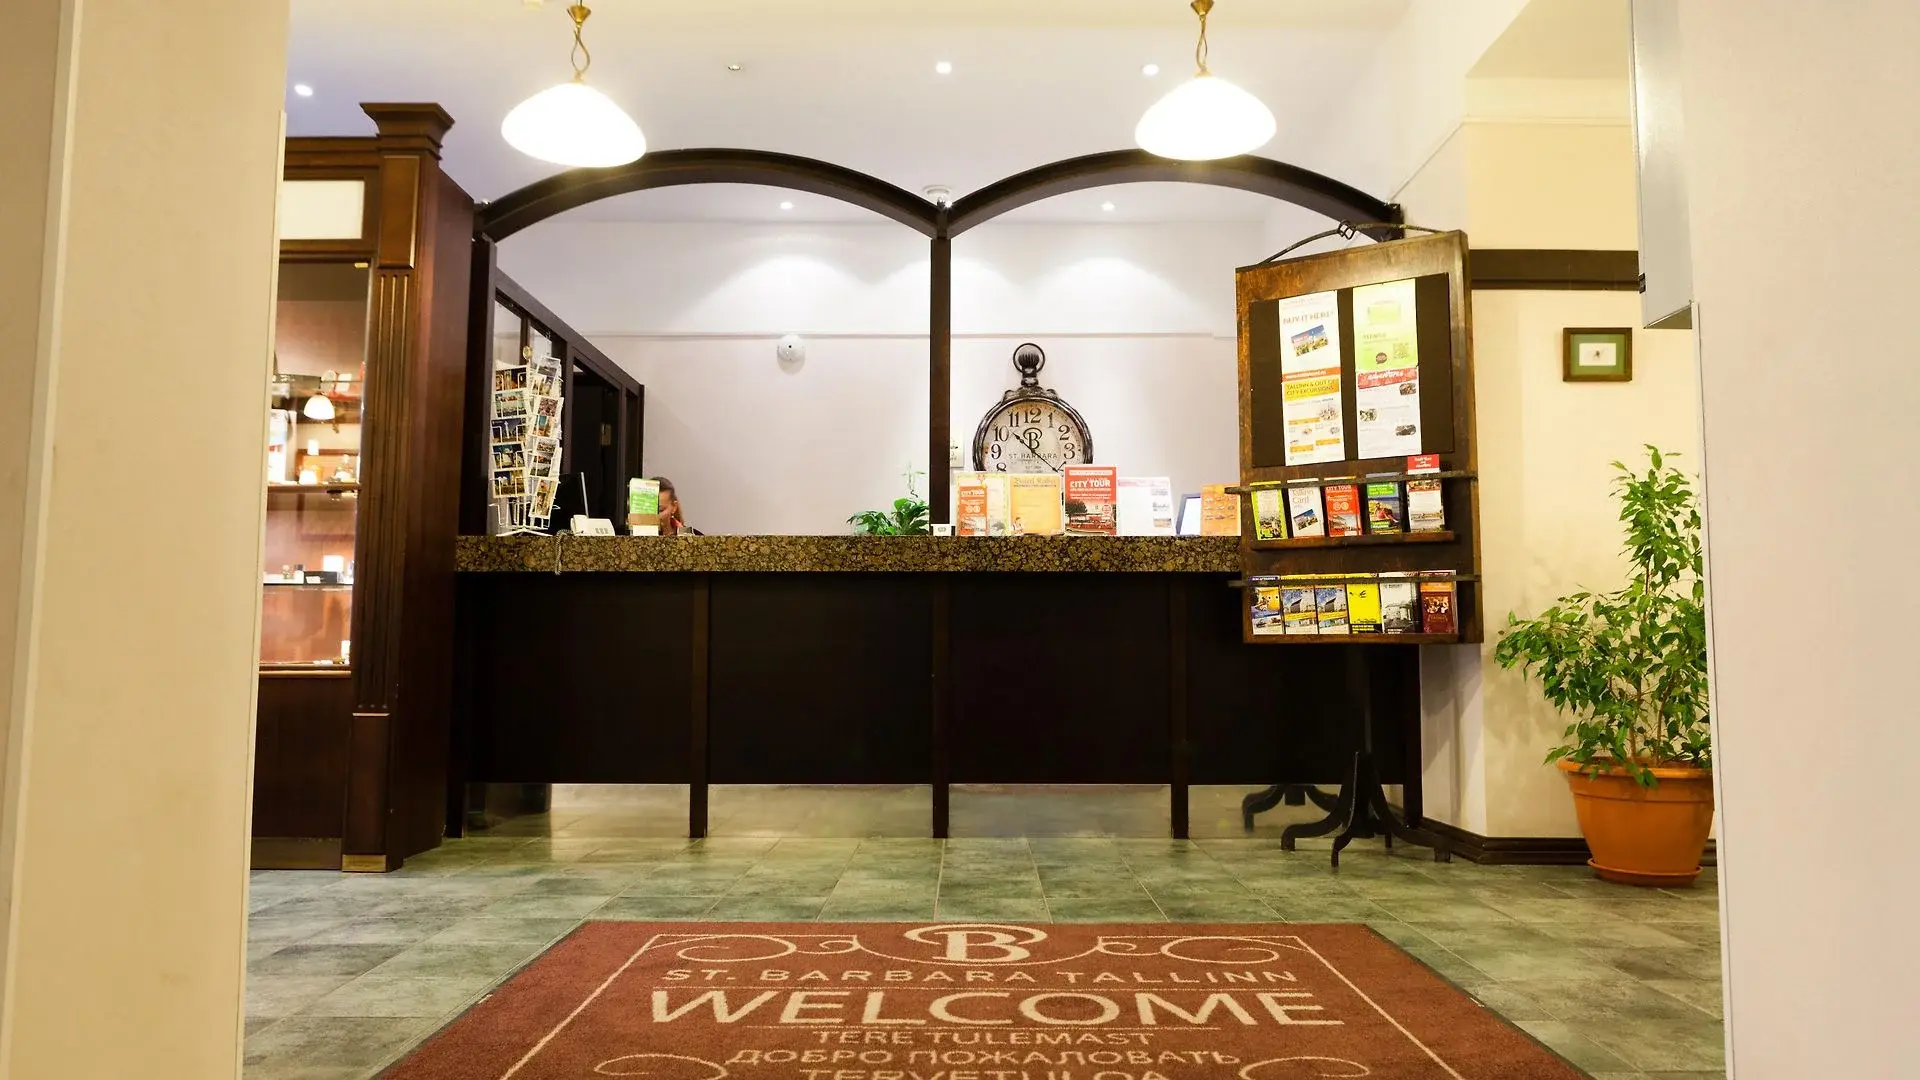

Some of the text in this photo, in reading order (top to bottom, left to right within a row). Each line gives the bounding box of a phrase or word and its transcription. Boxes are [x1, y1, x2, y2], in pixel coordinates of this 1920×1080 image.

[1008, 411, 1020, 428] 11
[1024, 407, 1042, 424] 12
[1048, 412, 1055, 428] 1
[993, 425, 1009, 442] 10
[1058, 424, 1071, 440] 2
[991, 443, 1001, 460] 9
[1063, 442, 1075, 459] 3
[1070, 480, 1088, 488] CITY
[1089, 479, 1111, 488] TOUR
[904, 923, 1048, 963] B
[662, 969, 1298, 984] ST. BARBARA TALLINN
[652, 990, 1345, 1026] WELCOME
[812, 1031, 1154, 1045] TERE TULEMAST
[724, 1049, 1241, 1066] ДОБРО ПОЖАЛОВАТЬ
